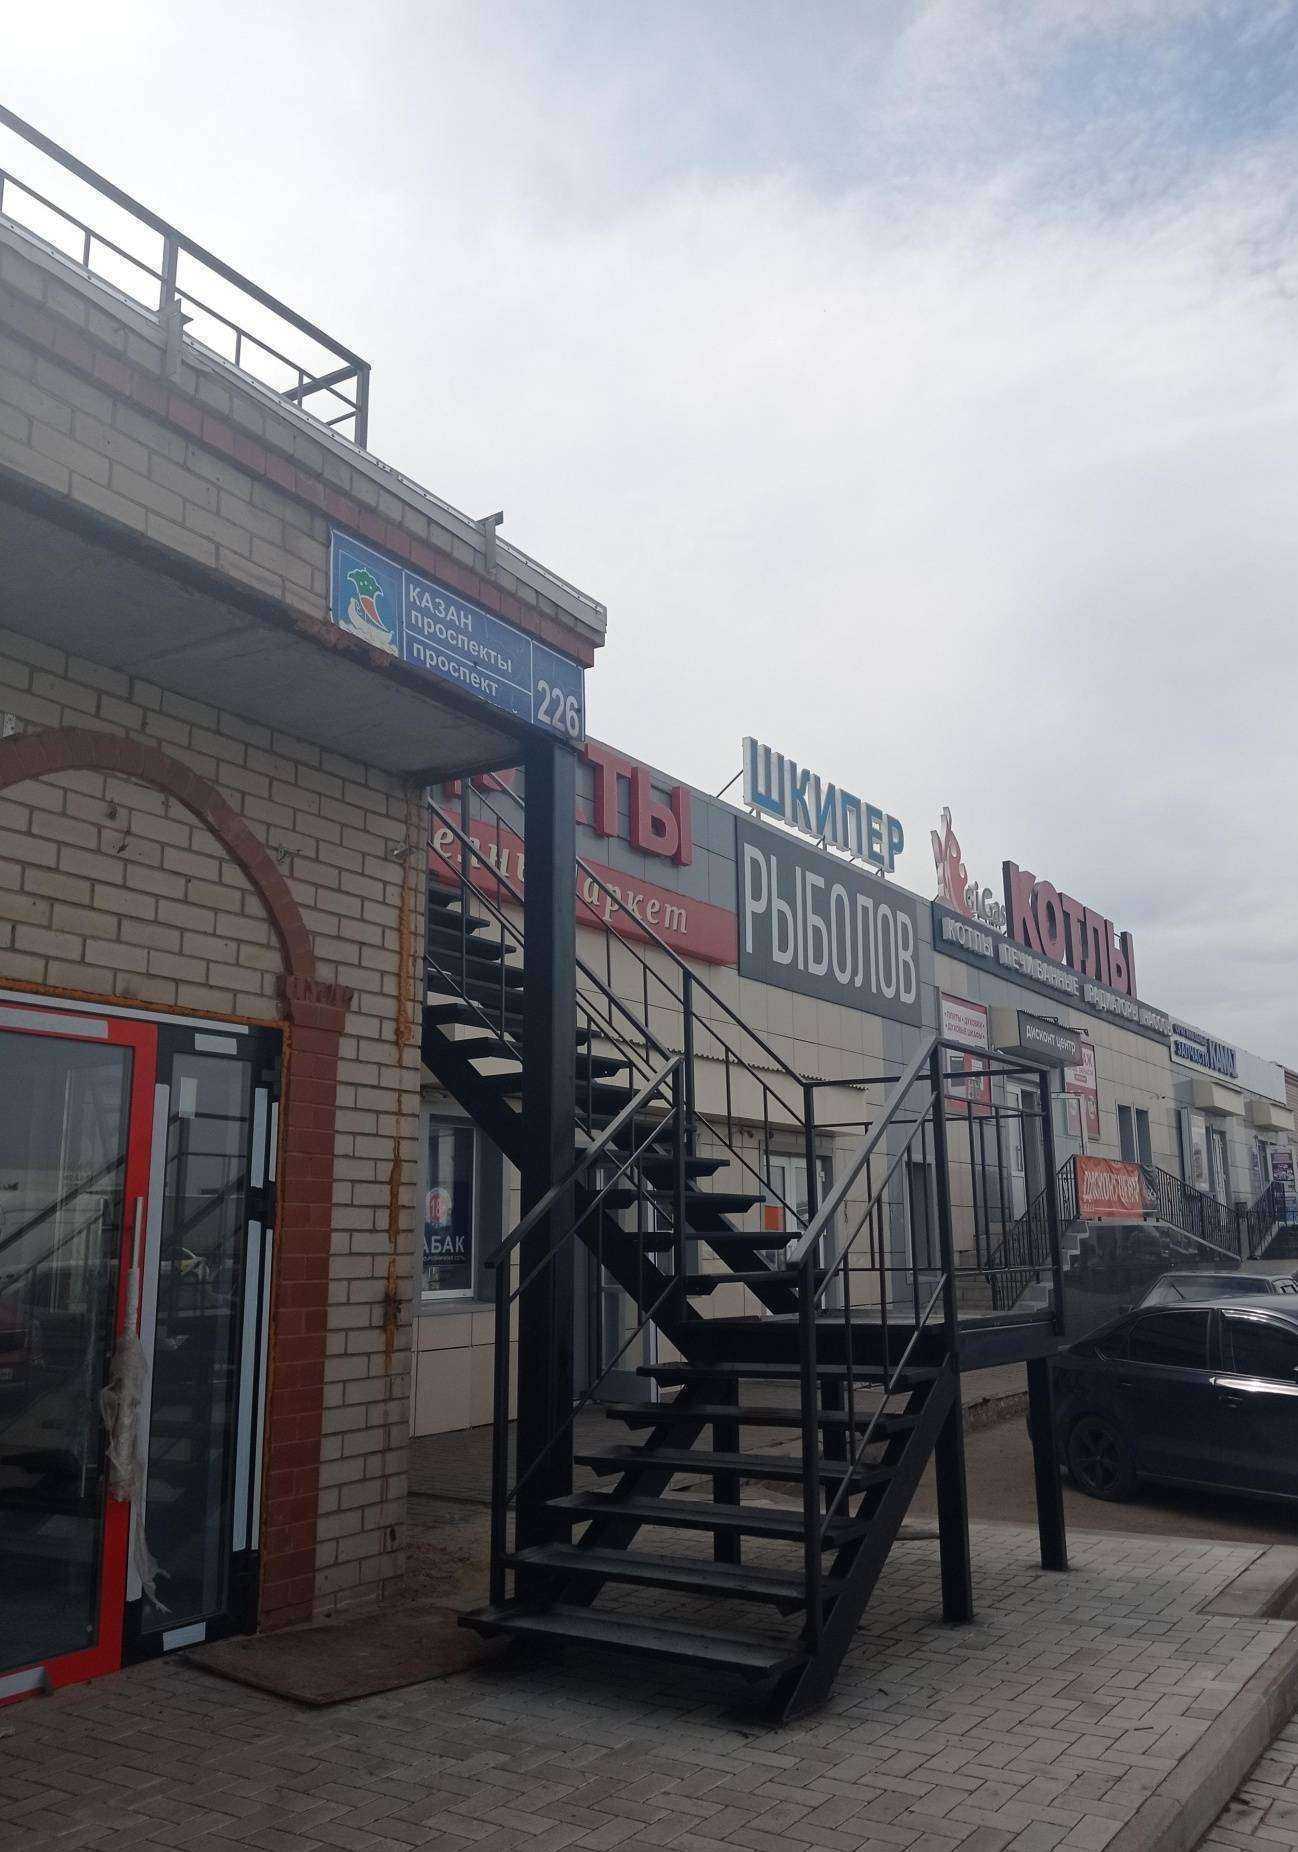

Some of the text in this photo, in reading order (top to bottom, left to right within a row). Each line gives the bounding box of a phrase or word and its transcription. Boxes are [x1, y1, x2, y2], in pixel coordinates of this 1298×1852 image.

[409, 583, 473, 632] КАЗАН
[411, 610, 513, 673] проспекты
[412, 642, 499, 697] проспект
[537, 679, 580, 738] 226
[743, 736, 904, 873] ШКИПЕР
[743, 843, 917, 1005] РЫБОЛОВ
[941, 917, 994, 957] КОТЛЫ
[1002, 860, 1138, 1004] КОТЛЫ
